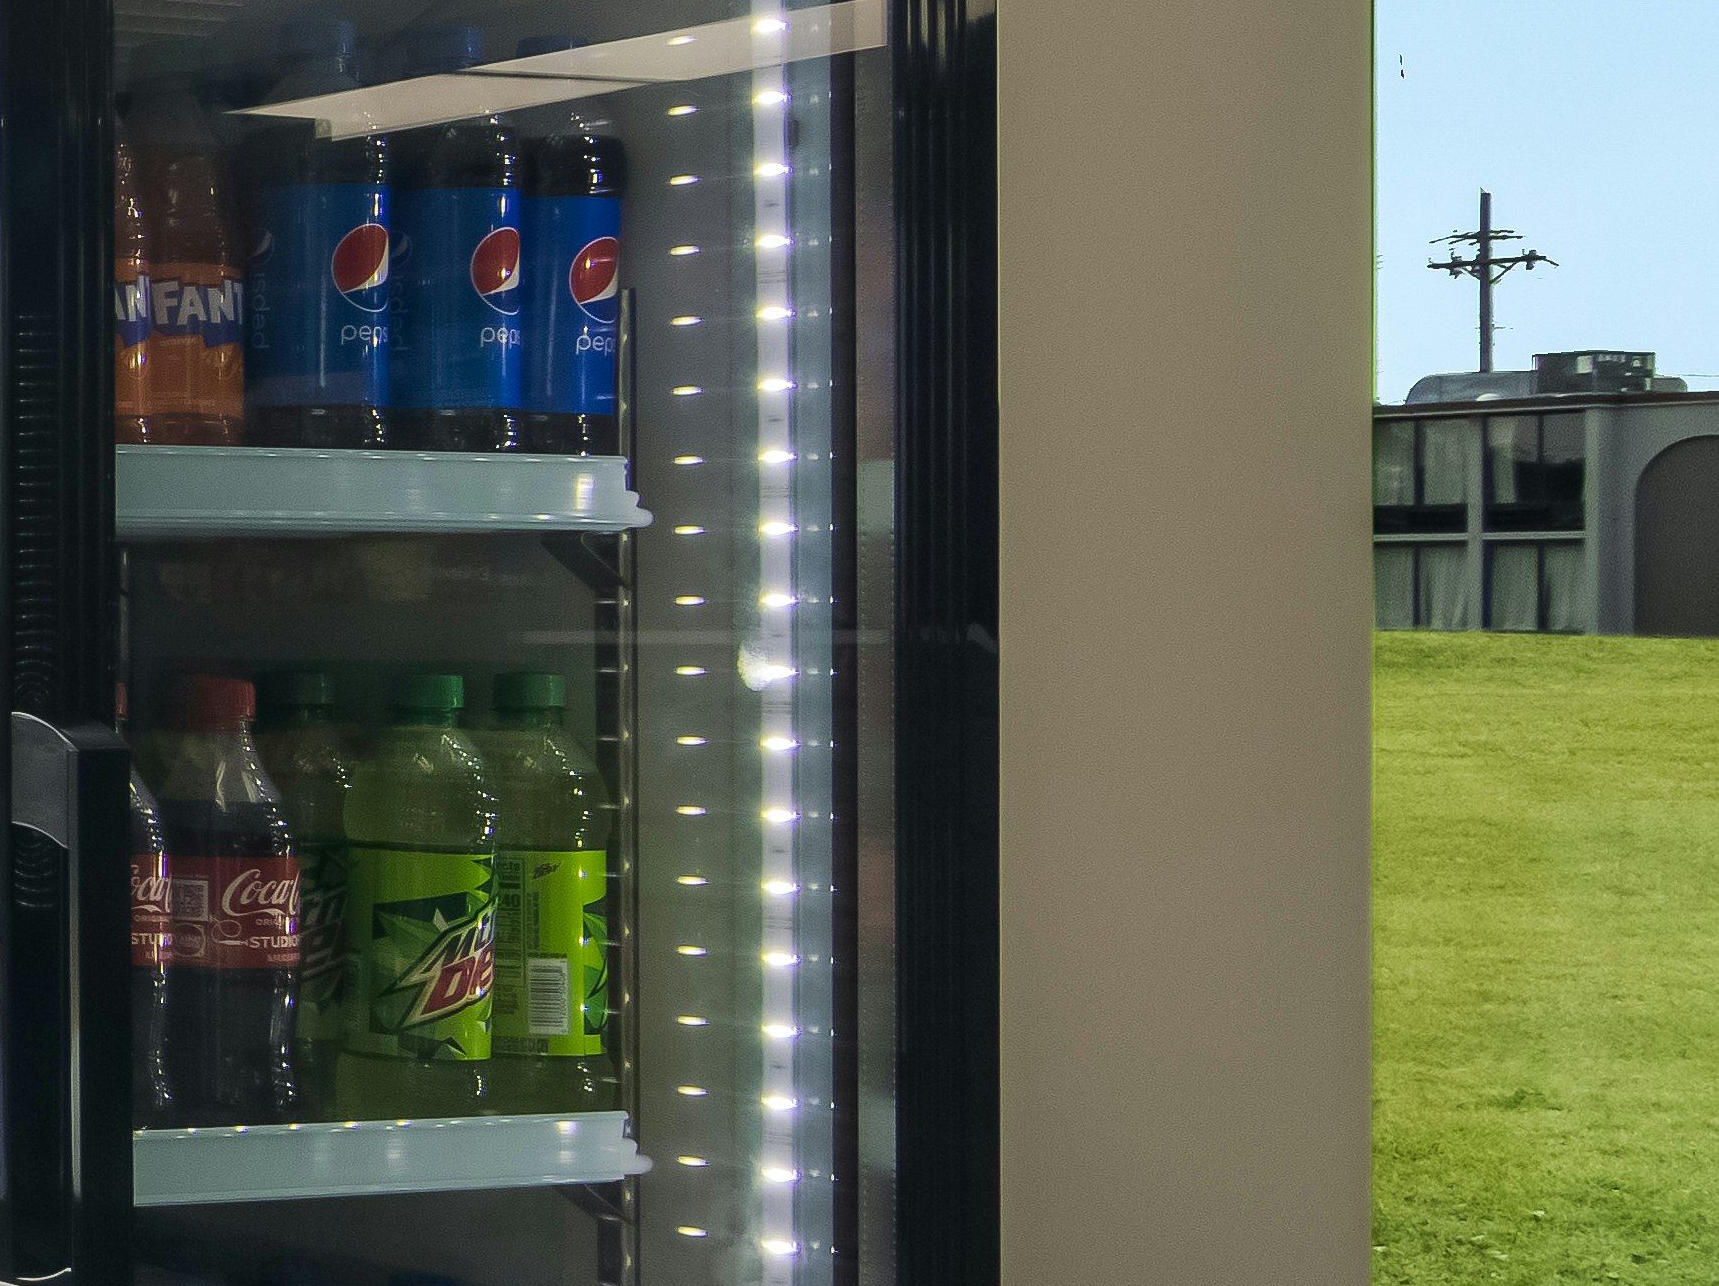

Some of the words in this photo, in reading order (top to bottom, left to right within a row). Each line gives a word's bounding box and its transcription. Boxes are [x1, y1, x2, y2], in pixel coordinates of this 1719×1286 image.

[152, 280, 243, 326] FANT
[340, 324, 389, 346] peps
[575, 334, 616, 356] pep
[420, 946, 495, 1016] DE
